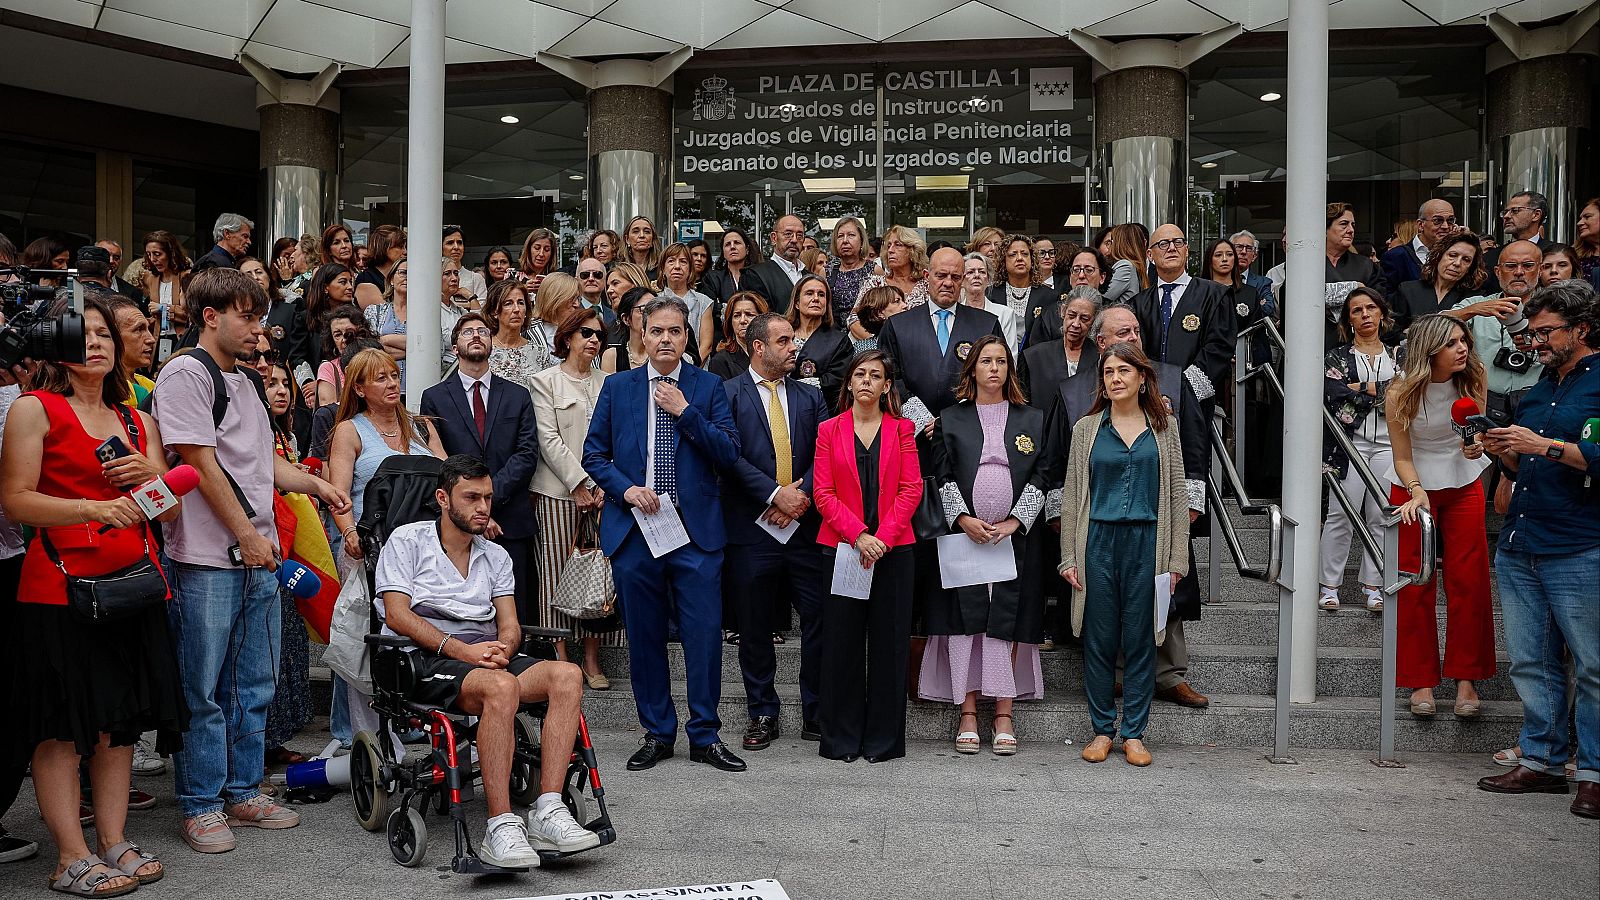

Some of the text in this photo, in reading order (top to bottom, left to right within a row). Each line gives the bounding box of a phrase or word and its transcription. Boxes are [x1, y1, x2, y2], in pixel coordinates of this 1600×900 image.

[759, 68, 1020, 94] PLAZA DE CASTILLA 1
[744, 94, 1003, 122] Juzgados de Instrucción
[683, 120, 1072, 150] Juzgados de Vigilancia Penitenciaria
[683, 146, 1072, 174] Decanato de los Juzgados de Madrid
[623, 884, 733, 899] ASESINAR
